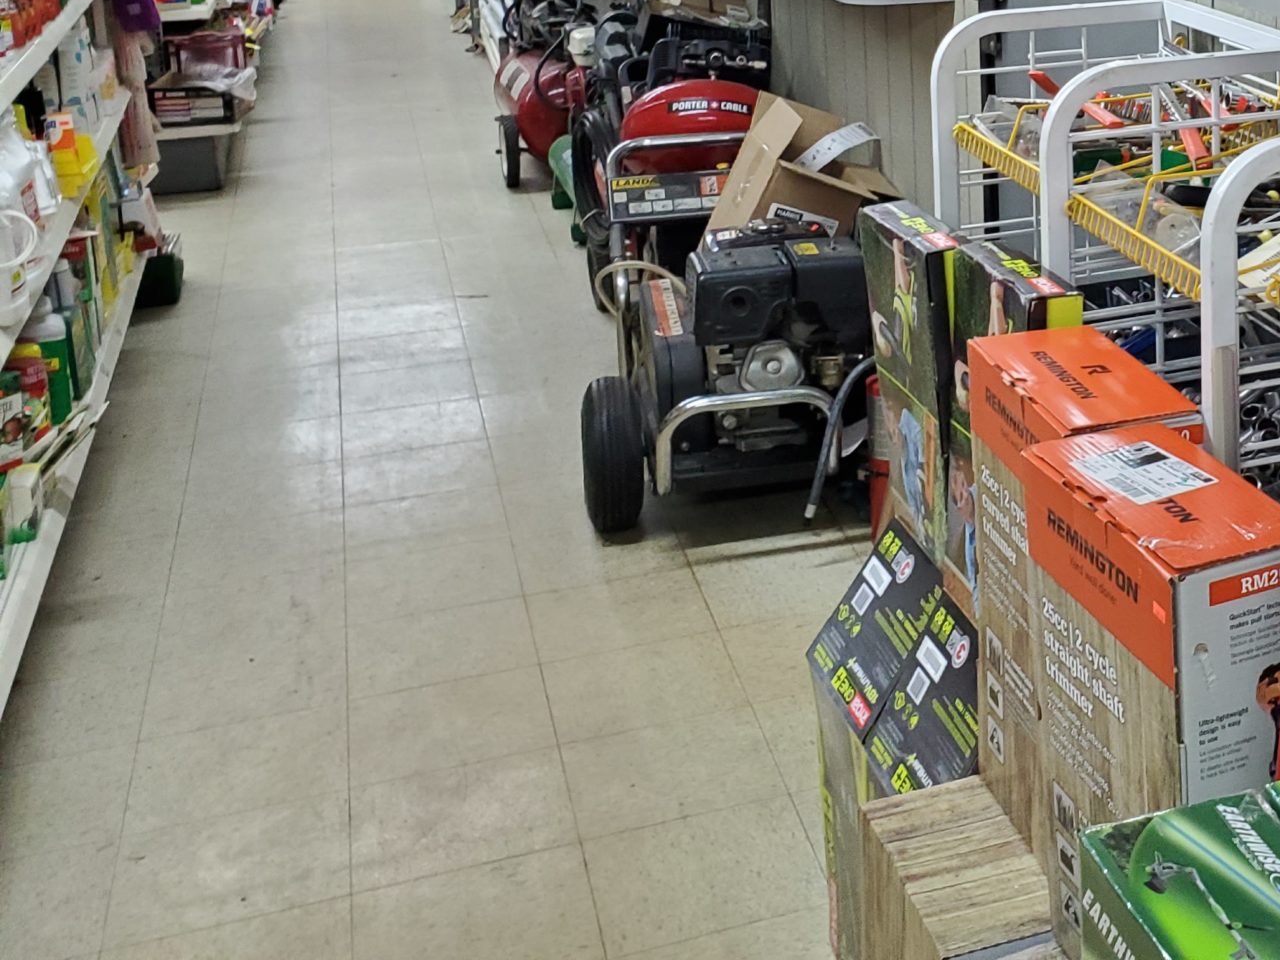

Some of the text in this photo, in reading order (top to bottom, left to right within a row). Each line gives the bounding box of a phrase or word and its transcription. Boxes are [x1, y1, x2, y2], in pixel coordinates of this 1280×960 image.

[672, 100, 749, 114] PORTER CABLE
[1030, 350, 1098, 400] REMINGTON
[985, 386, 1040, 445] REMINGTO
[982, 516, 1017, 566] trimmer
[1010, 500, 1027, 529] cyc
[1047, 508, 1139, 604] REMINGTON
[1042, 597, 1117, 685] 25cc 2 cycle
[1044, 630, 1091, 688] straight
[1092, 679, 1125, 723] shaft
[1046, 656, 1093, 718] trimmer
[1082, 889, 1136, 960] EARTH
